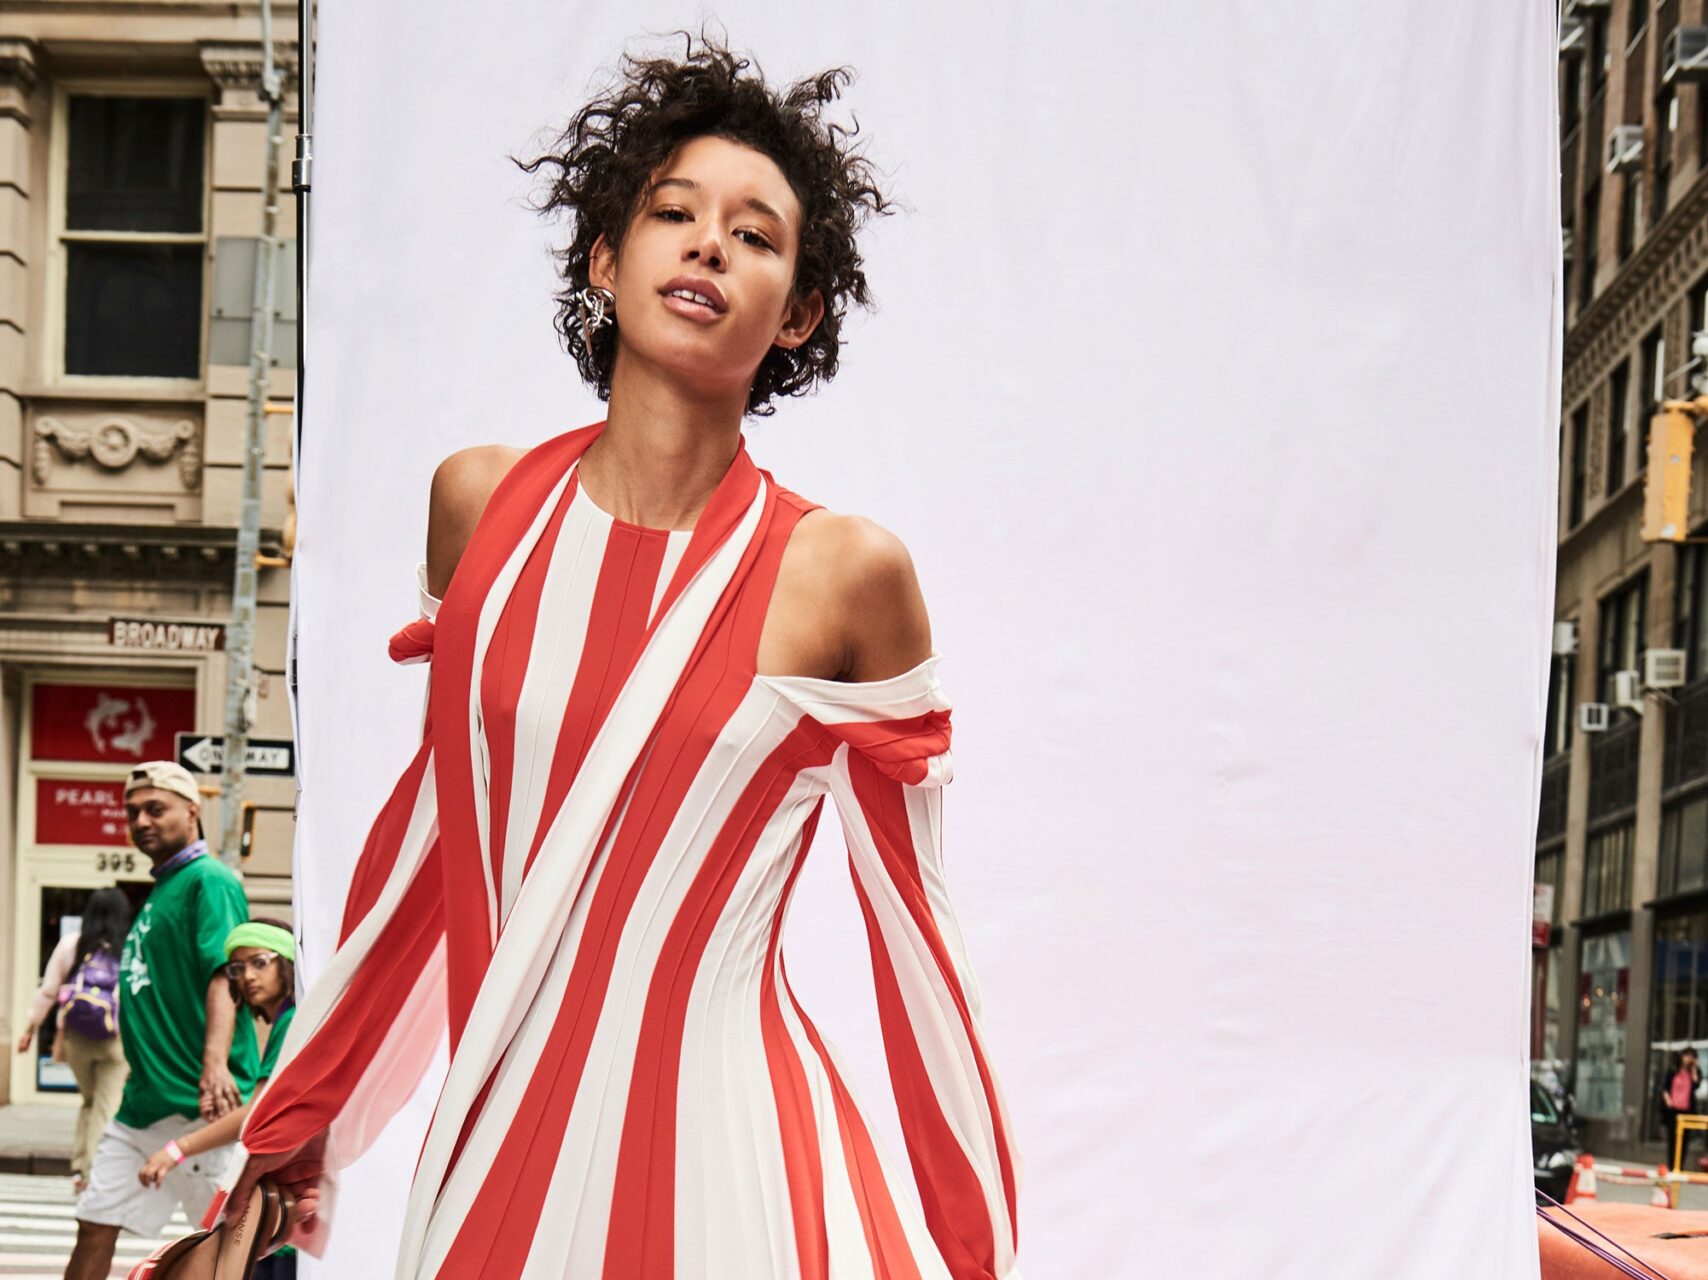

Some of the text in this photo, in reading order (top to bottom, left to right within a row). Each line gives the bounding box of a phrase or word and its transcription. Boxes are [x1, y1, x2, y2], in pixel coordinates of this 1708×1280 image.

[114, 621, 219, 649] BROADWAY
[55, 789, 118, 806] PEARL
[97, 854, 135, 872] 395
